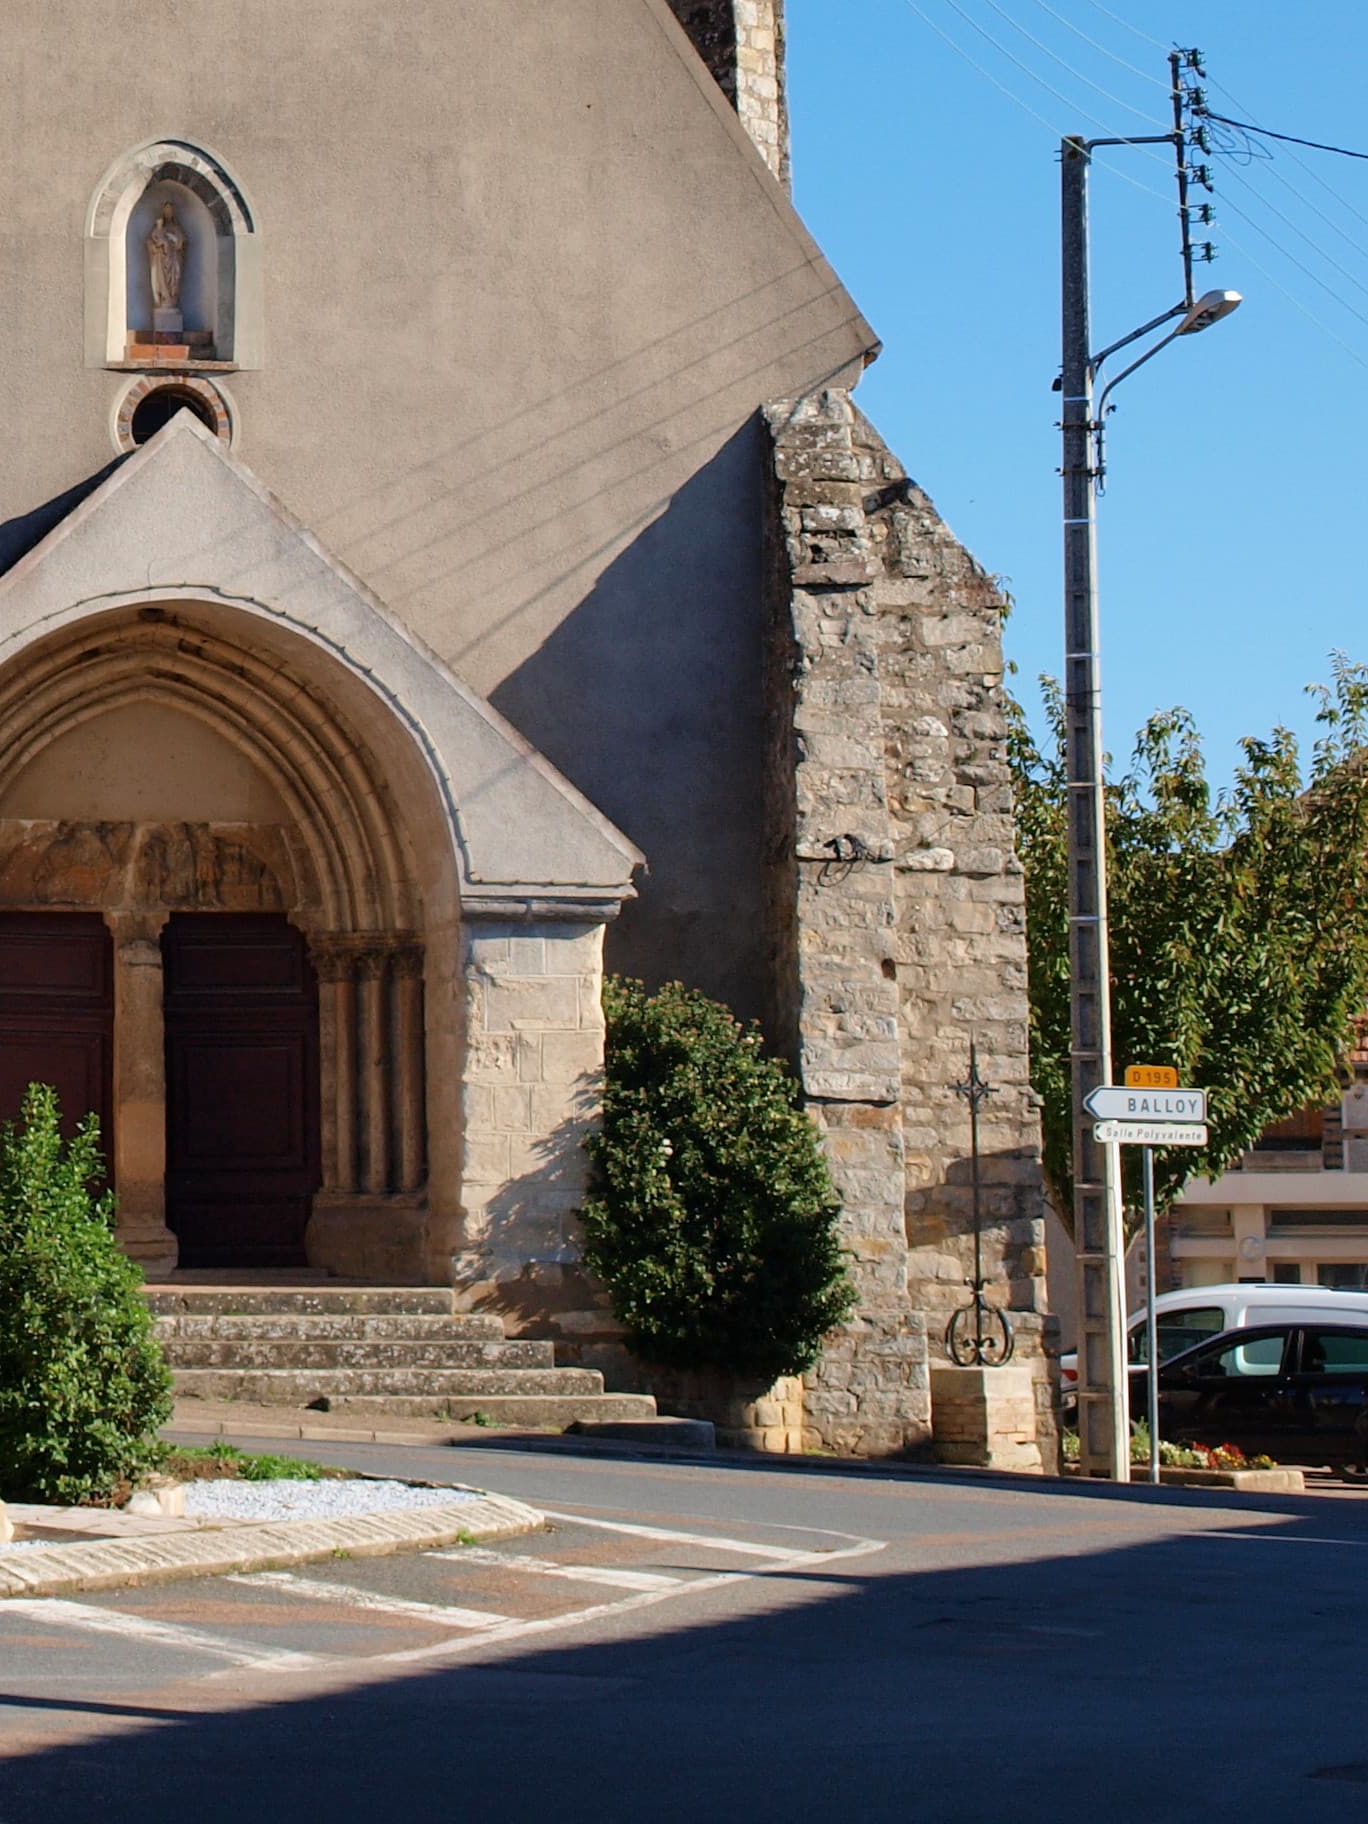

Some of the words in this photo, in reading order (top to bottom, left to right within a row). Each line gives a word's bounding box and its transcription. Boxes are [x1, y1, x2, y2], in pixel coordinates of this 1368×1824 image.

[1132, 1071, 1141, 1082] D
[1146, 1071, 1171, 1084] 195
[1127, 1097, 1199, 1115] BALLOY
[1106, 1127, 1133, 1139] Salle
[1136, 1128, 1203, 1142] Polyvalente
